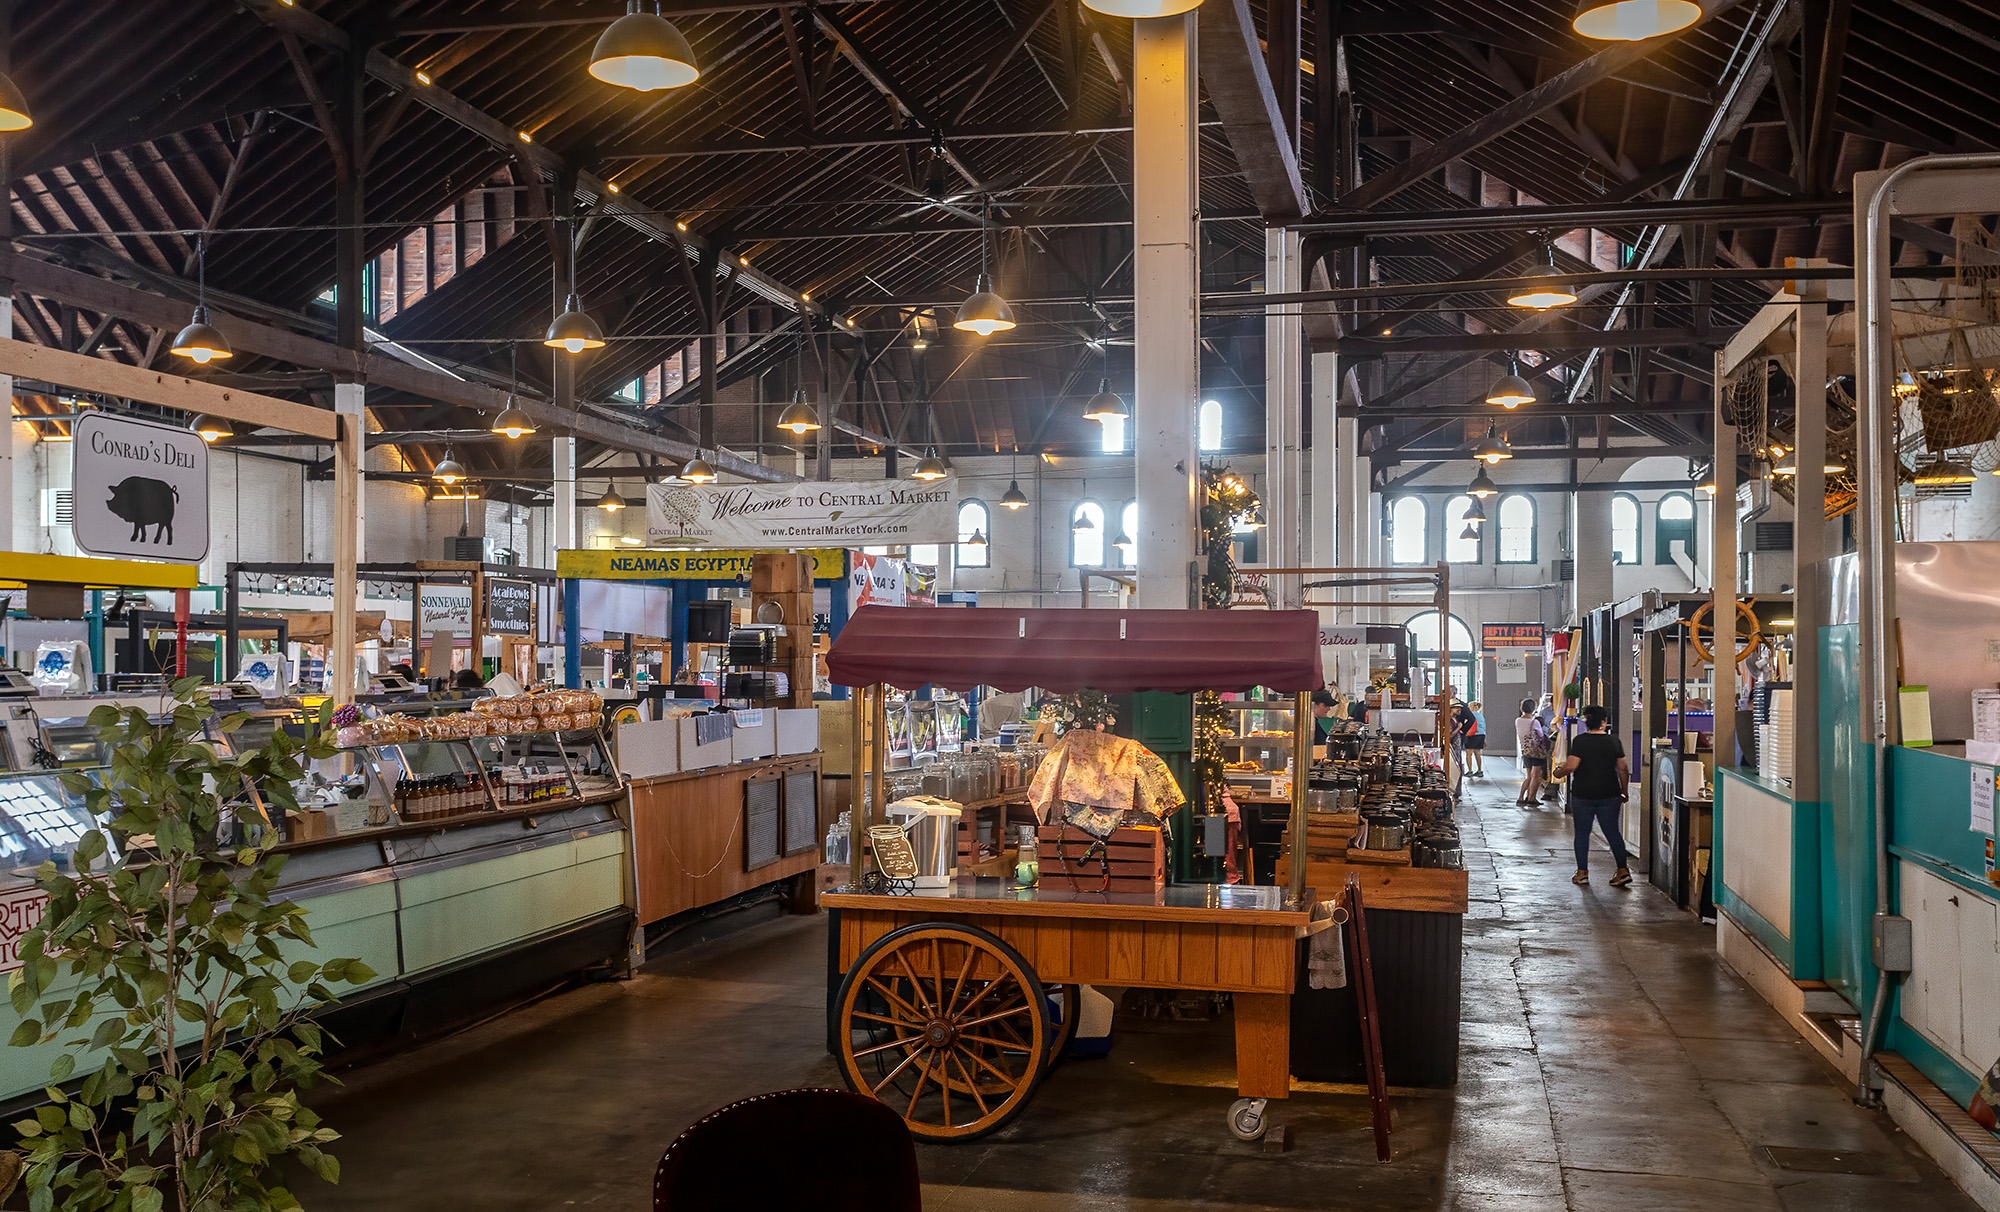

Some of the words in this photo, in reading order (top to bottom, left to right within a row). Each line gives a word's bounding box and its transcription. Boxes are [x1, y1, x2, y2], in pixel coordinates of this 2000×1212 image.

[91, 430, 161, 463] CONRAD'S
[164, 443, 195, 469] DELI
[709, 488, 791, 521] Welcome
[819, 492, 885, 507] CENTRAL
[889, 490, 951, 505] MARKET
[649, 527, 680, 536] CENTRAL
[684, 527, 713, 536] MARKET
[762, 523, 908, 537] www.CentralMarketYork.com
[610, 557, 680, 572] NEAMAS
[685, 557, 754, 572] EGYPTIA
[510, 588, 530, 600] Bowls
[421, 596, 472, 608] SONNEWALD
[425, 609, 451, 623] Natural
[450, 605, 469, 620] Foods
[490, 618, 529, 631] Smoothies
[1483, 626, 1509, 637] HEFTY
[1511, 626, 1543, 637] LEFTY'S
